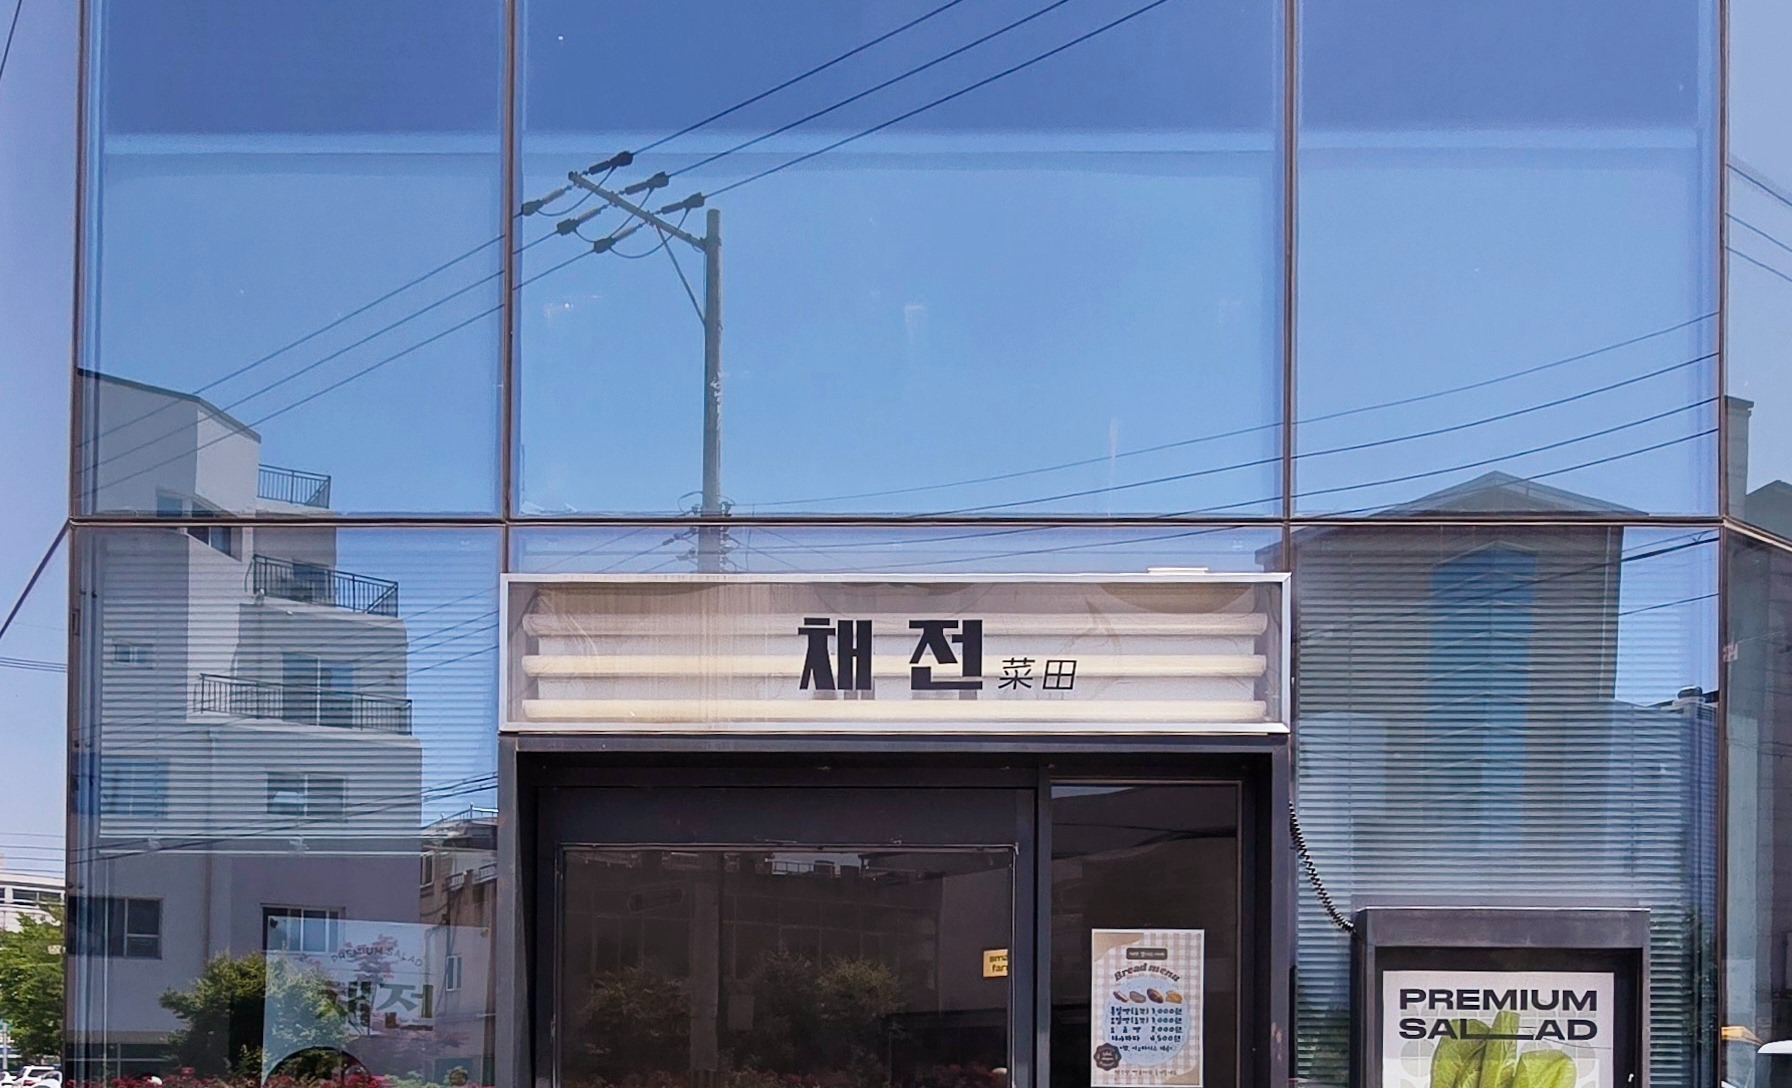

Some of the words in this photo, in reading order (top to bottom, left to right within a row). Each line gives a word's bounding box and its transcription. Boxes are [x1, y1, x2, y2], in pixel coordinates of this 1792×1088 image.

[997, 656, 1077, 691] 菜田
[330, 944, 384, 963] PREMIUM
[386, 947, 423, 967] SALAD
[1114, 962, 1147, 981] Bread
[1148, 964, 1181, 982] menu
[1399, 988, 1597, 1012] PREMIUM
[1398, 1018, 1598, 1041] SALAD
